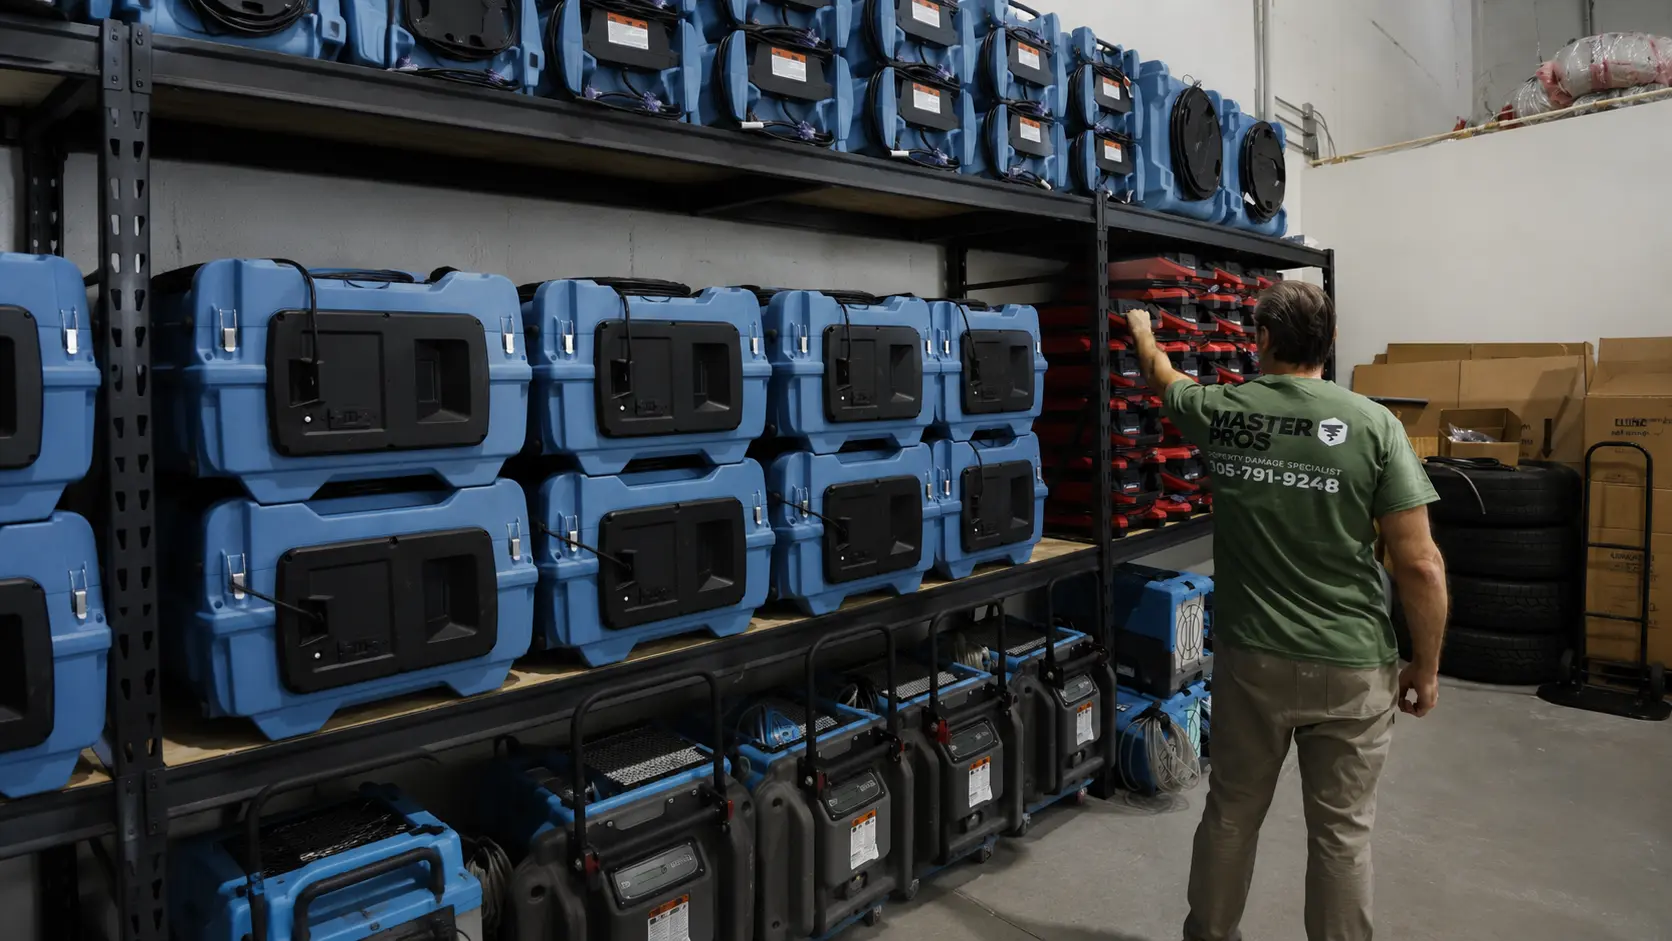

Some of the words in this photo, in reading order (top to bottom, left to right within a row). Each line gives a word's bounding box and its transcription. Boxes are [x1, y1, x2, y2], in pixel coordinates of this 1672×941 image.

[1210, 410, 1313, 437] MASTER
[1209, 427, 1272, 451] PROS
[1245, 456, 1284, 468] DAMAGE
[1287, 461, 1343, 476] SPECIALIST
